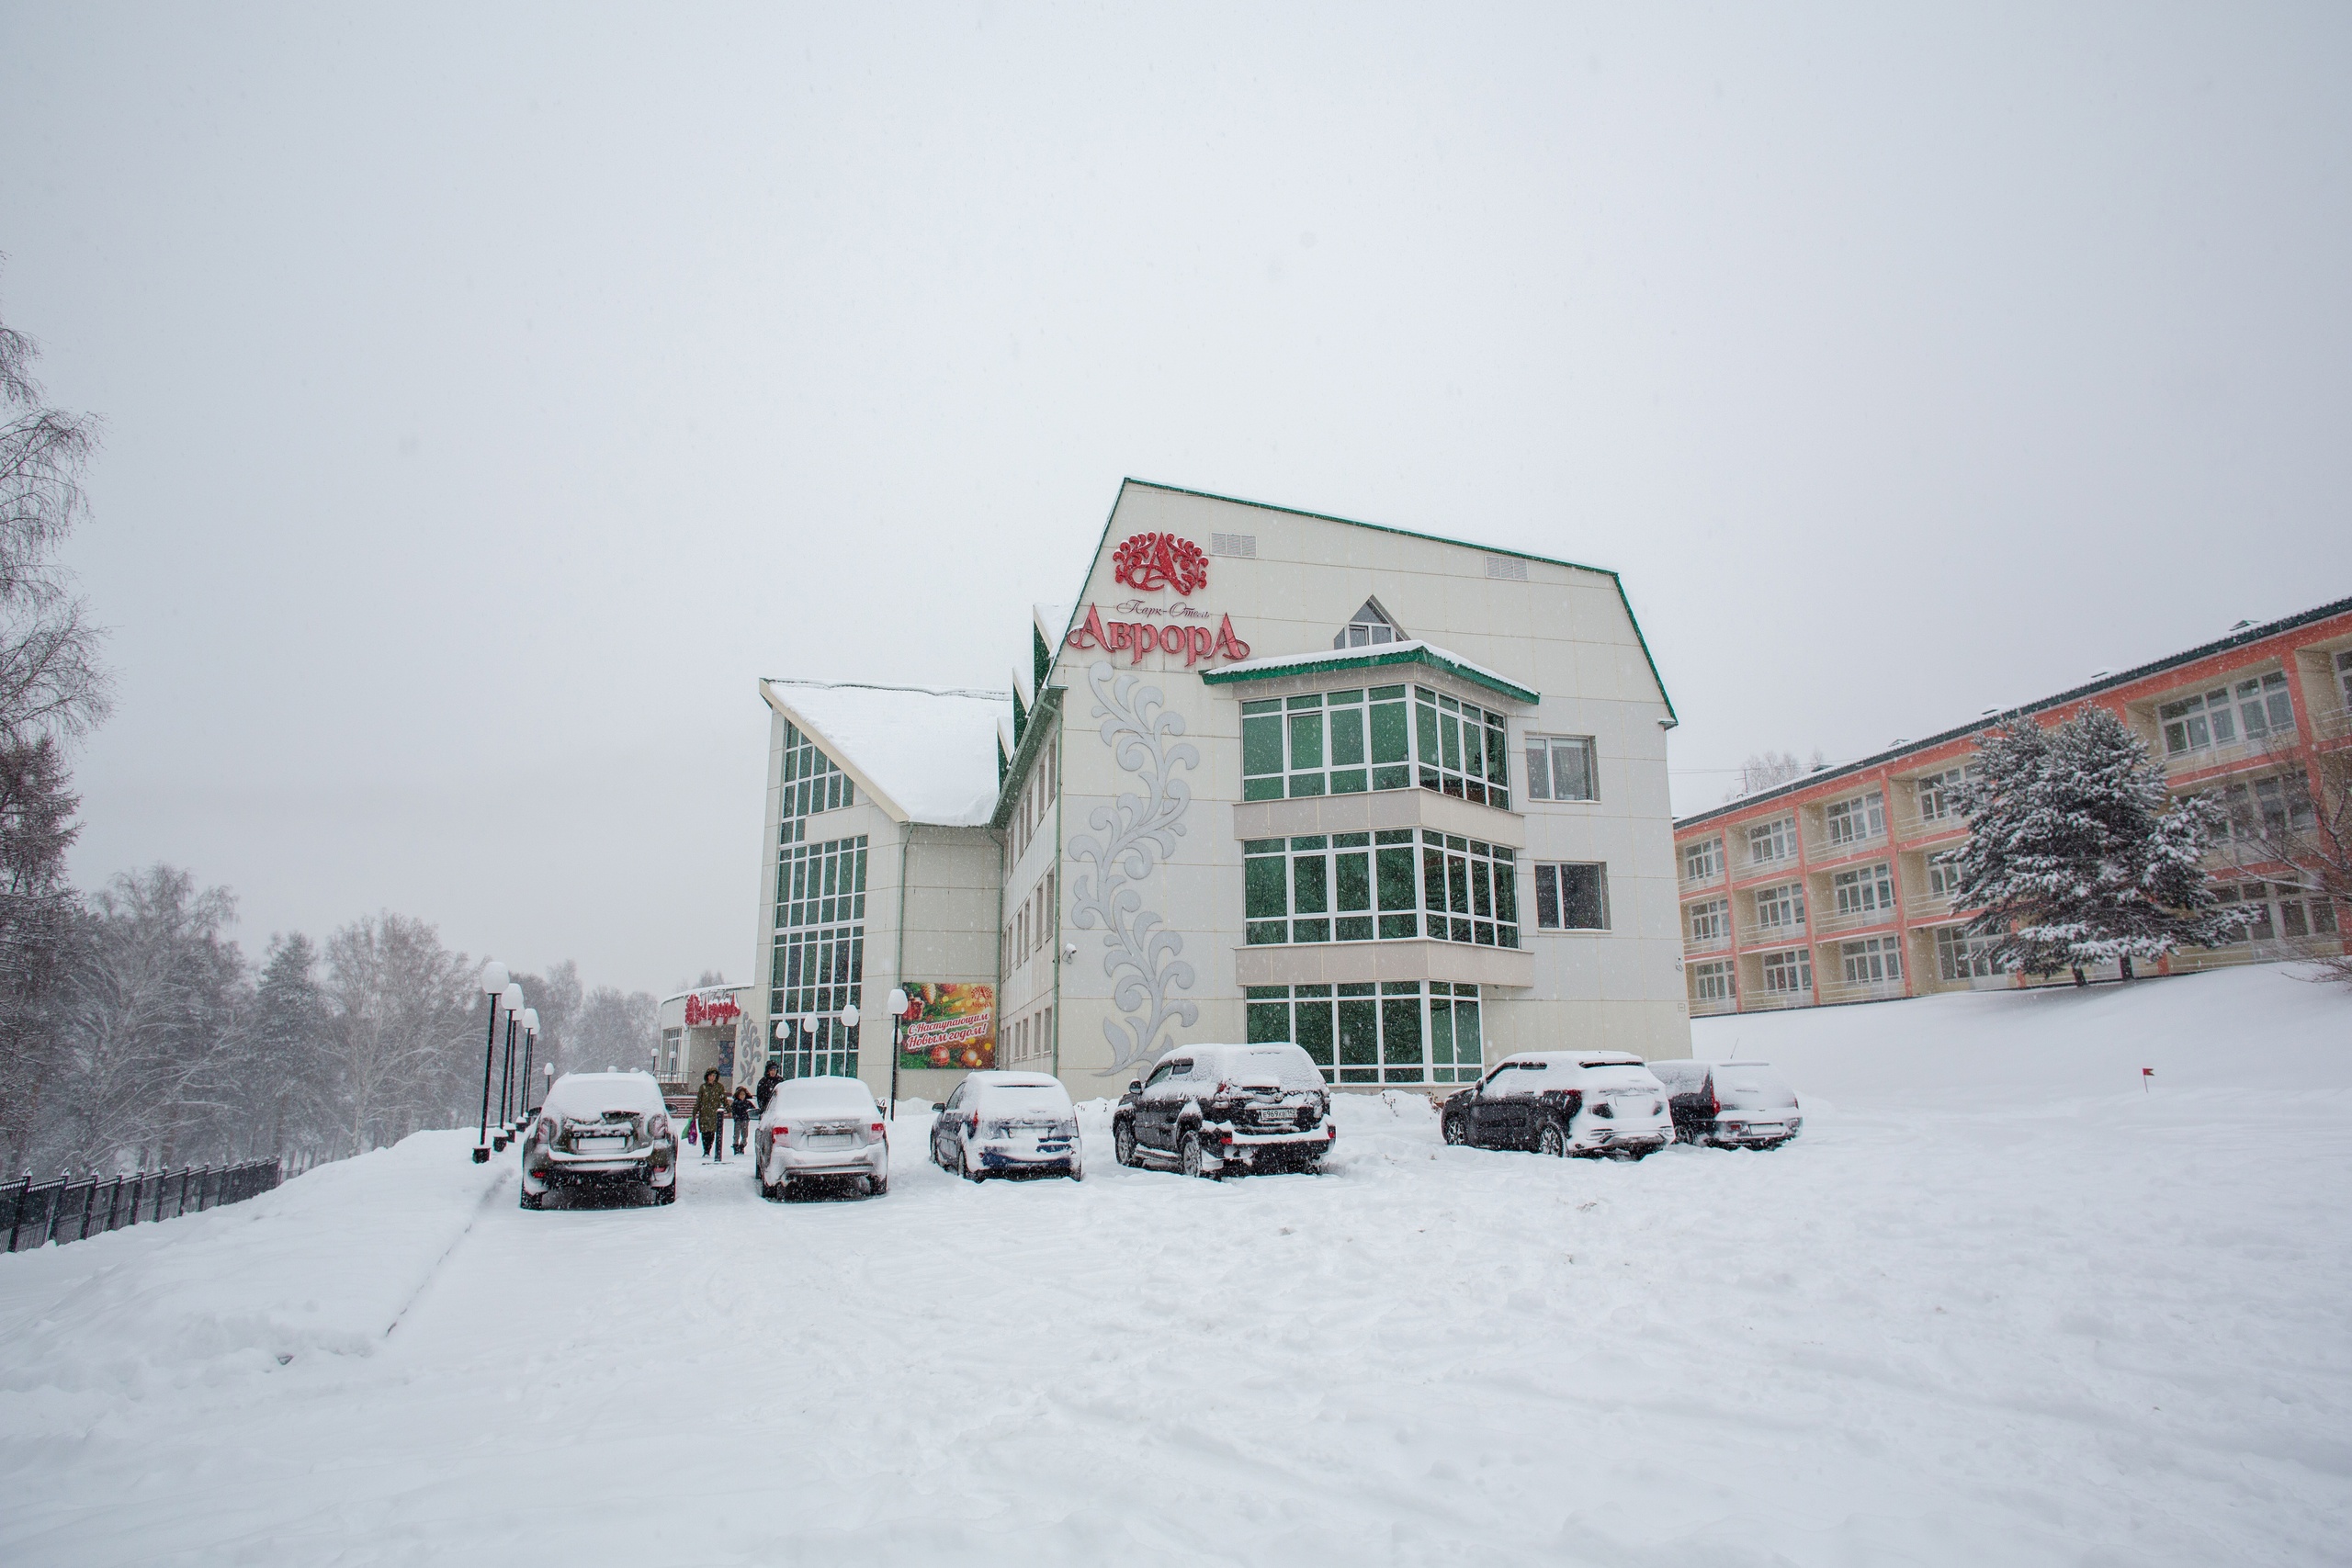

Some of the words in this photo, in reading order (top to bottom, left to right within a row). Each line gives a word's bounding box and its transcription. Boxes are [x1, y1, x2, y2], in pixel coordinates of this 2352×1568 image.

[908, 1024, 915, 1034] С
[917, 1013, 989, 1032] Наступающим
[908, 1034, 947, 1048] Новым
[949, 1023, 987, 1041] годом!
